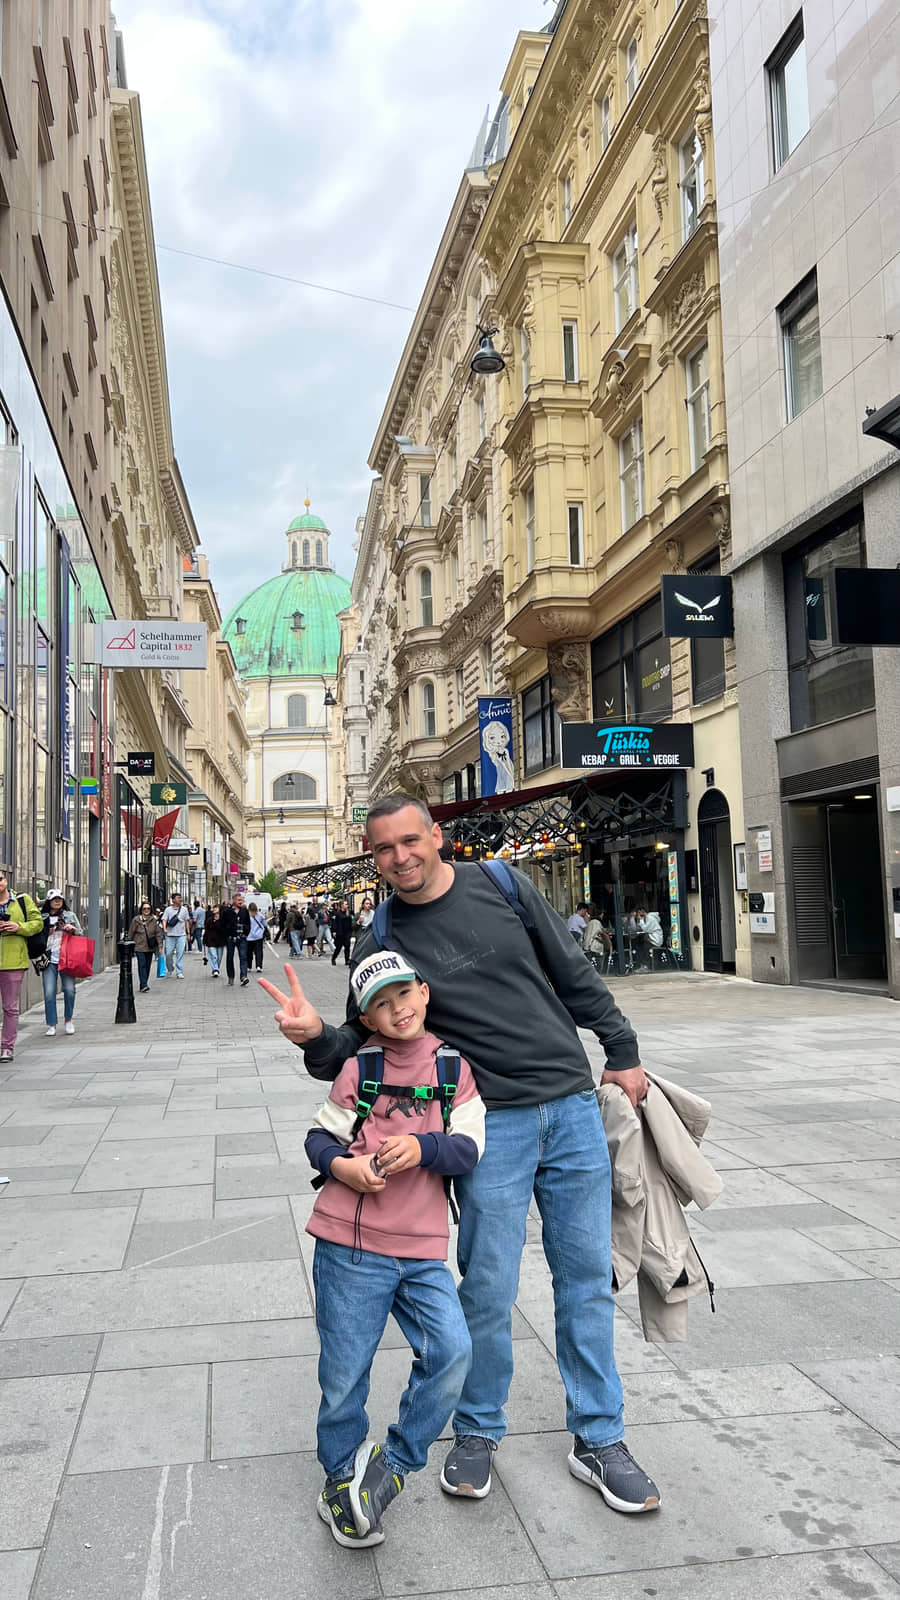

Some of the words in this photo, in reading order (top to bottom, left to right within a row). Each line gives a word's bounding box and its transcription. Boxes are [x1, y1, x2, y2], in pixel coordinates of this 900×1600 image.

[140, 632, 203, 641] Schelhammer
[140, 642, 172, 651] Capital
[174, 643, 193, 651] 1832
[597, 726, 654, 754] Türkis
[581, 754, 607, 766] KEBAP
[619, 754, 642, 765] GRILL
[653, 754, 680, 765] VEGGIE
[355, 956, 401, 992] LONDON
